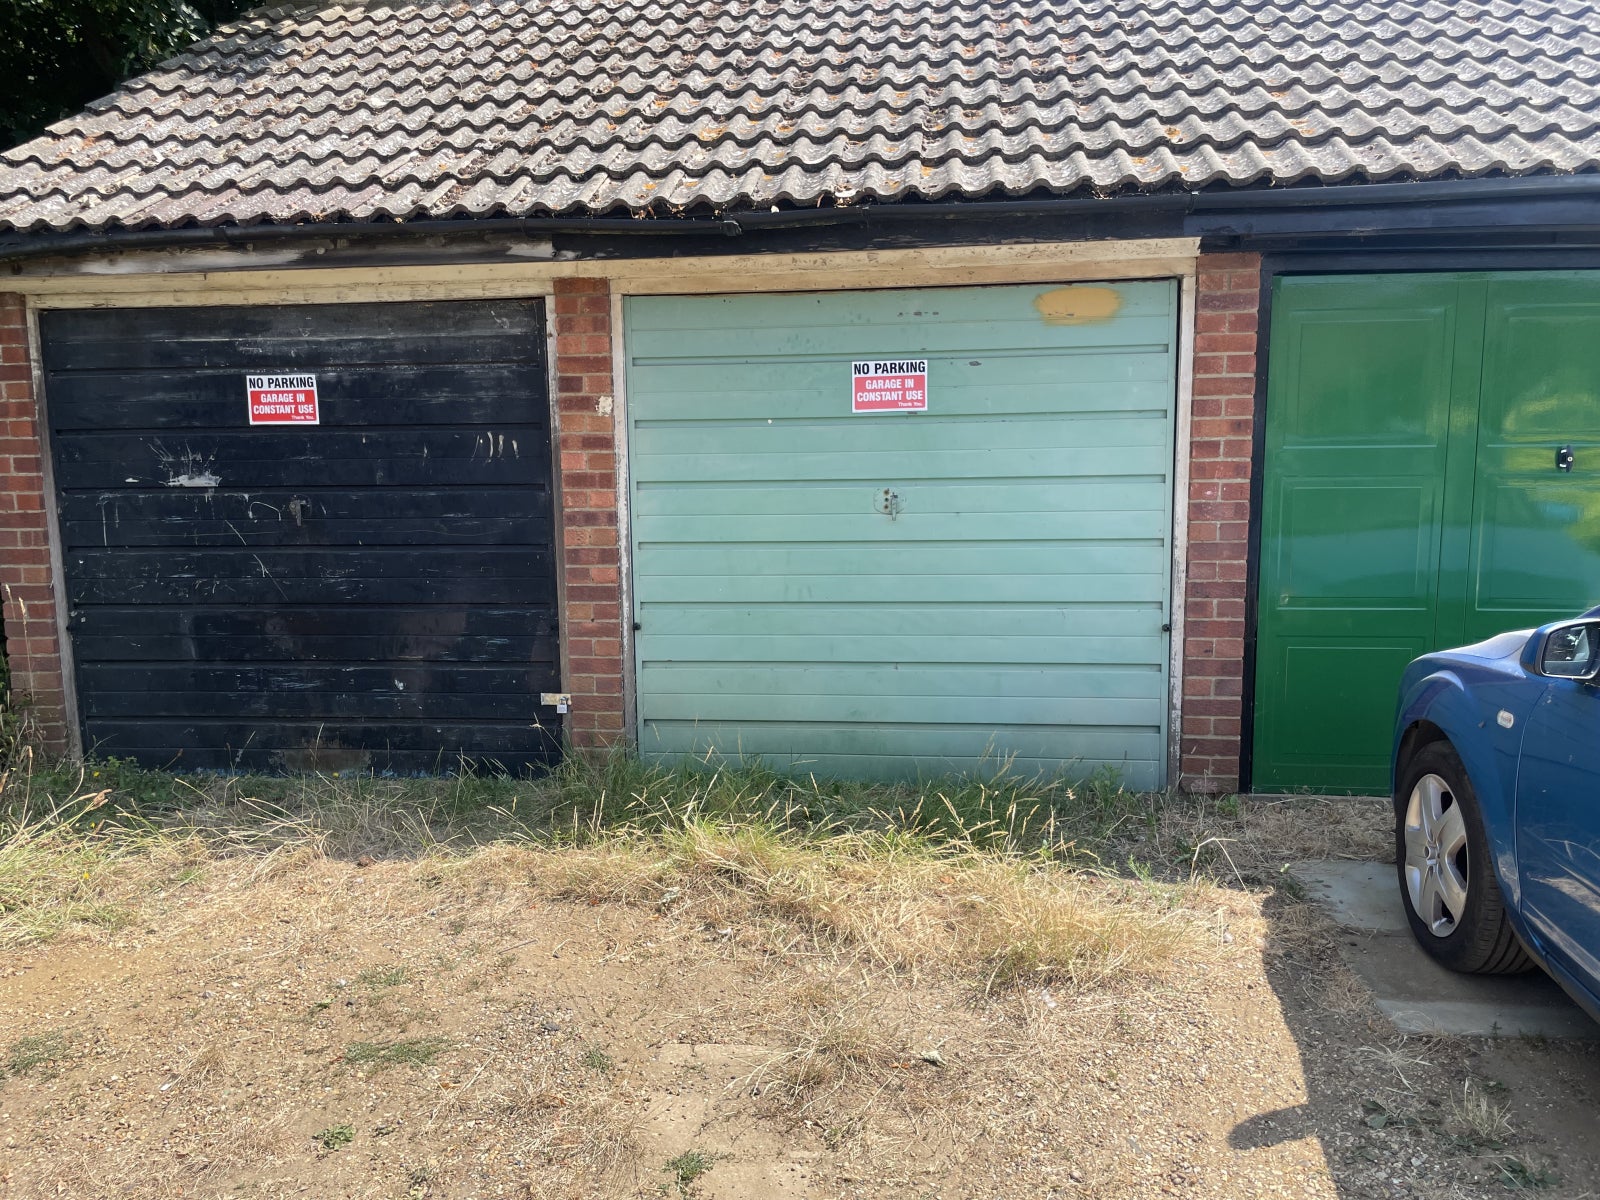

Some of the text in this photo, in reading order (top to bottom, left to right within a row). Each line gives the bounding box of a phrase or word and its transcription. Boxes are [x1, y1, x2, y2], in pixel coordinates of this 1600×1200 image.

[854, 361, 926, 375] NO PARKING
[249, 376, 314, 388] NO PARKING
[866, 378, 914, 390] GARAGE IN
[260, 393, 305, 402] GARAGE IN
[857, 390, 923, 402] CONSTANT USE
[254, 404, 314, 414] CONSTANT USE
